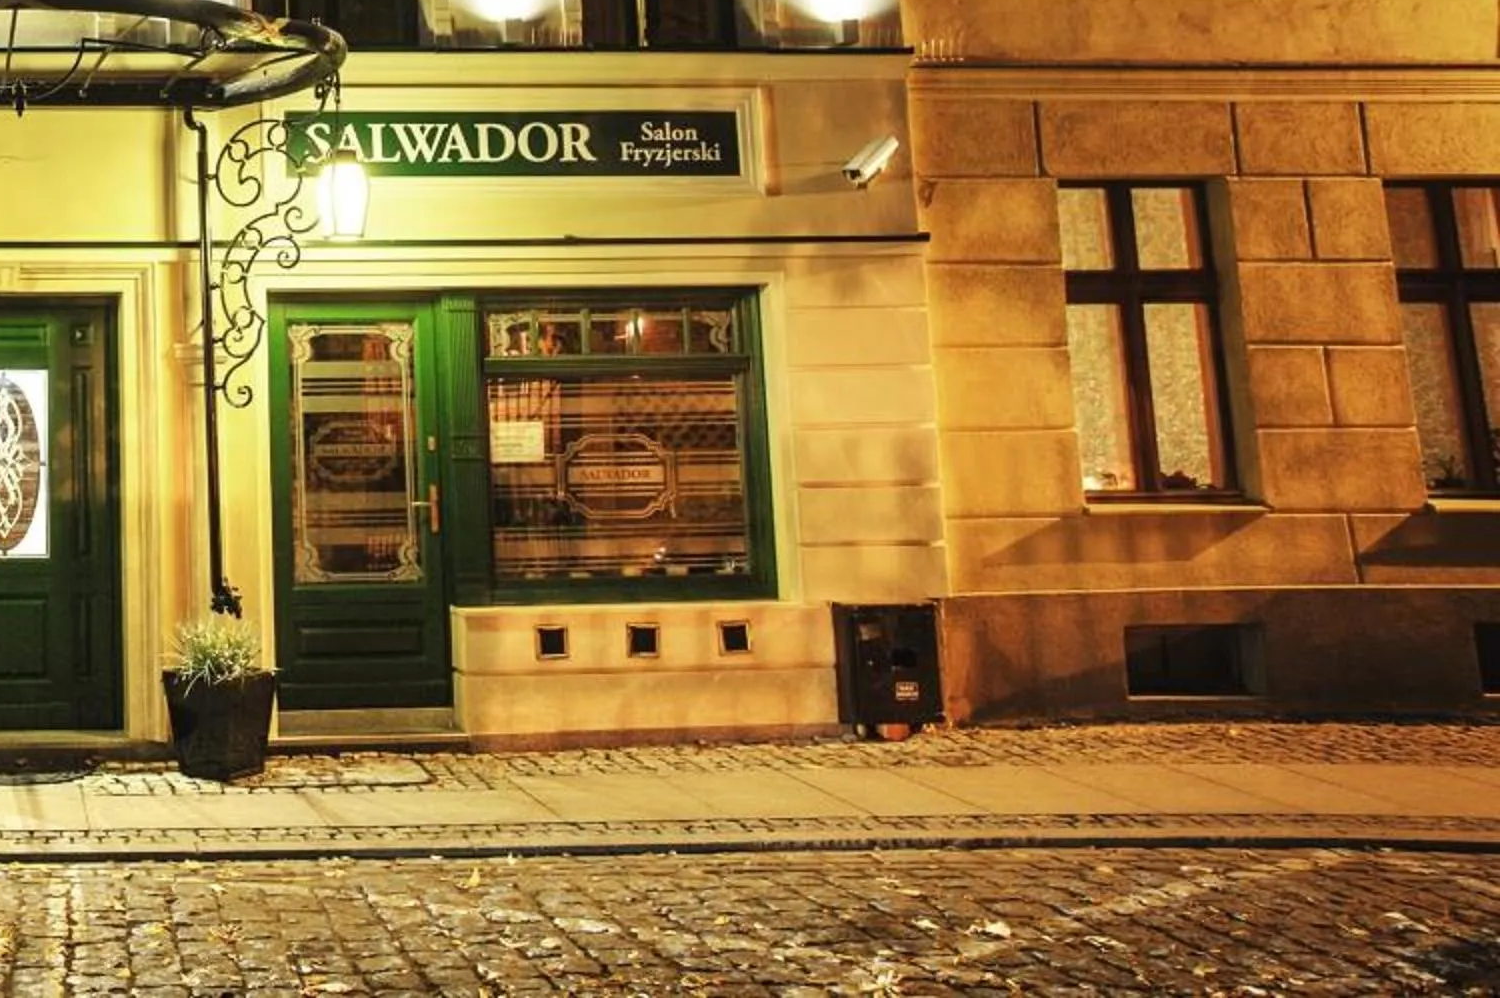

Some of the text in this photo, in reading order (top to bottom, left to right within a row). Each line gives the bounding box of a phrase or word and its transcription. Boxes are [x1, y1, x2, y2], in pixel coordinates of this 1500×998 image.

[303, 121, 597, 164] SALWADOR
[640, 121, 698, 141] Salon
[620, 141, 721, 168] Fryzjerski
